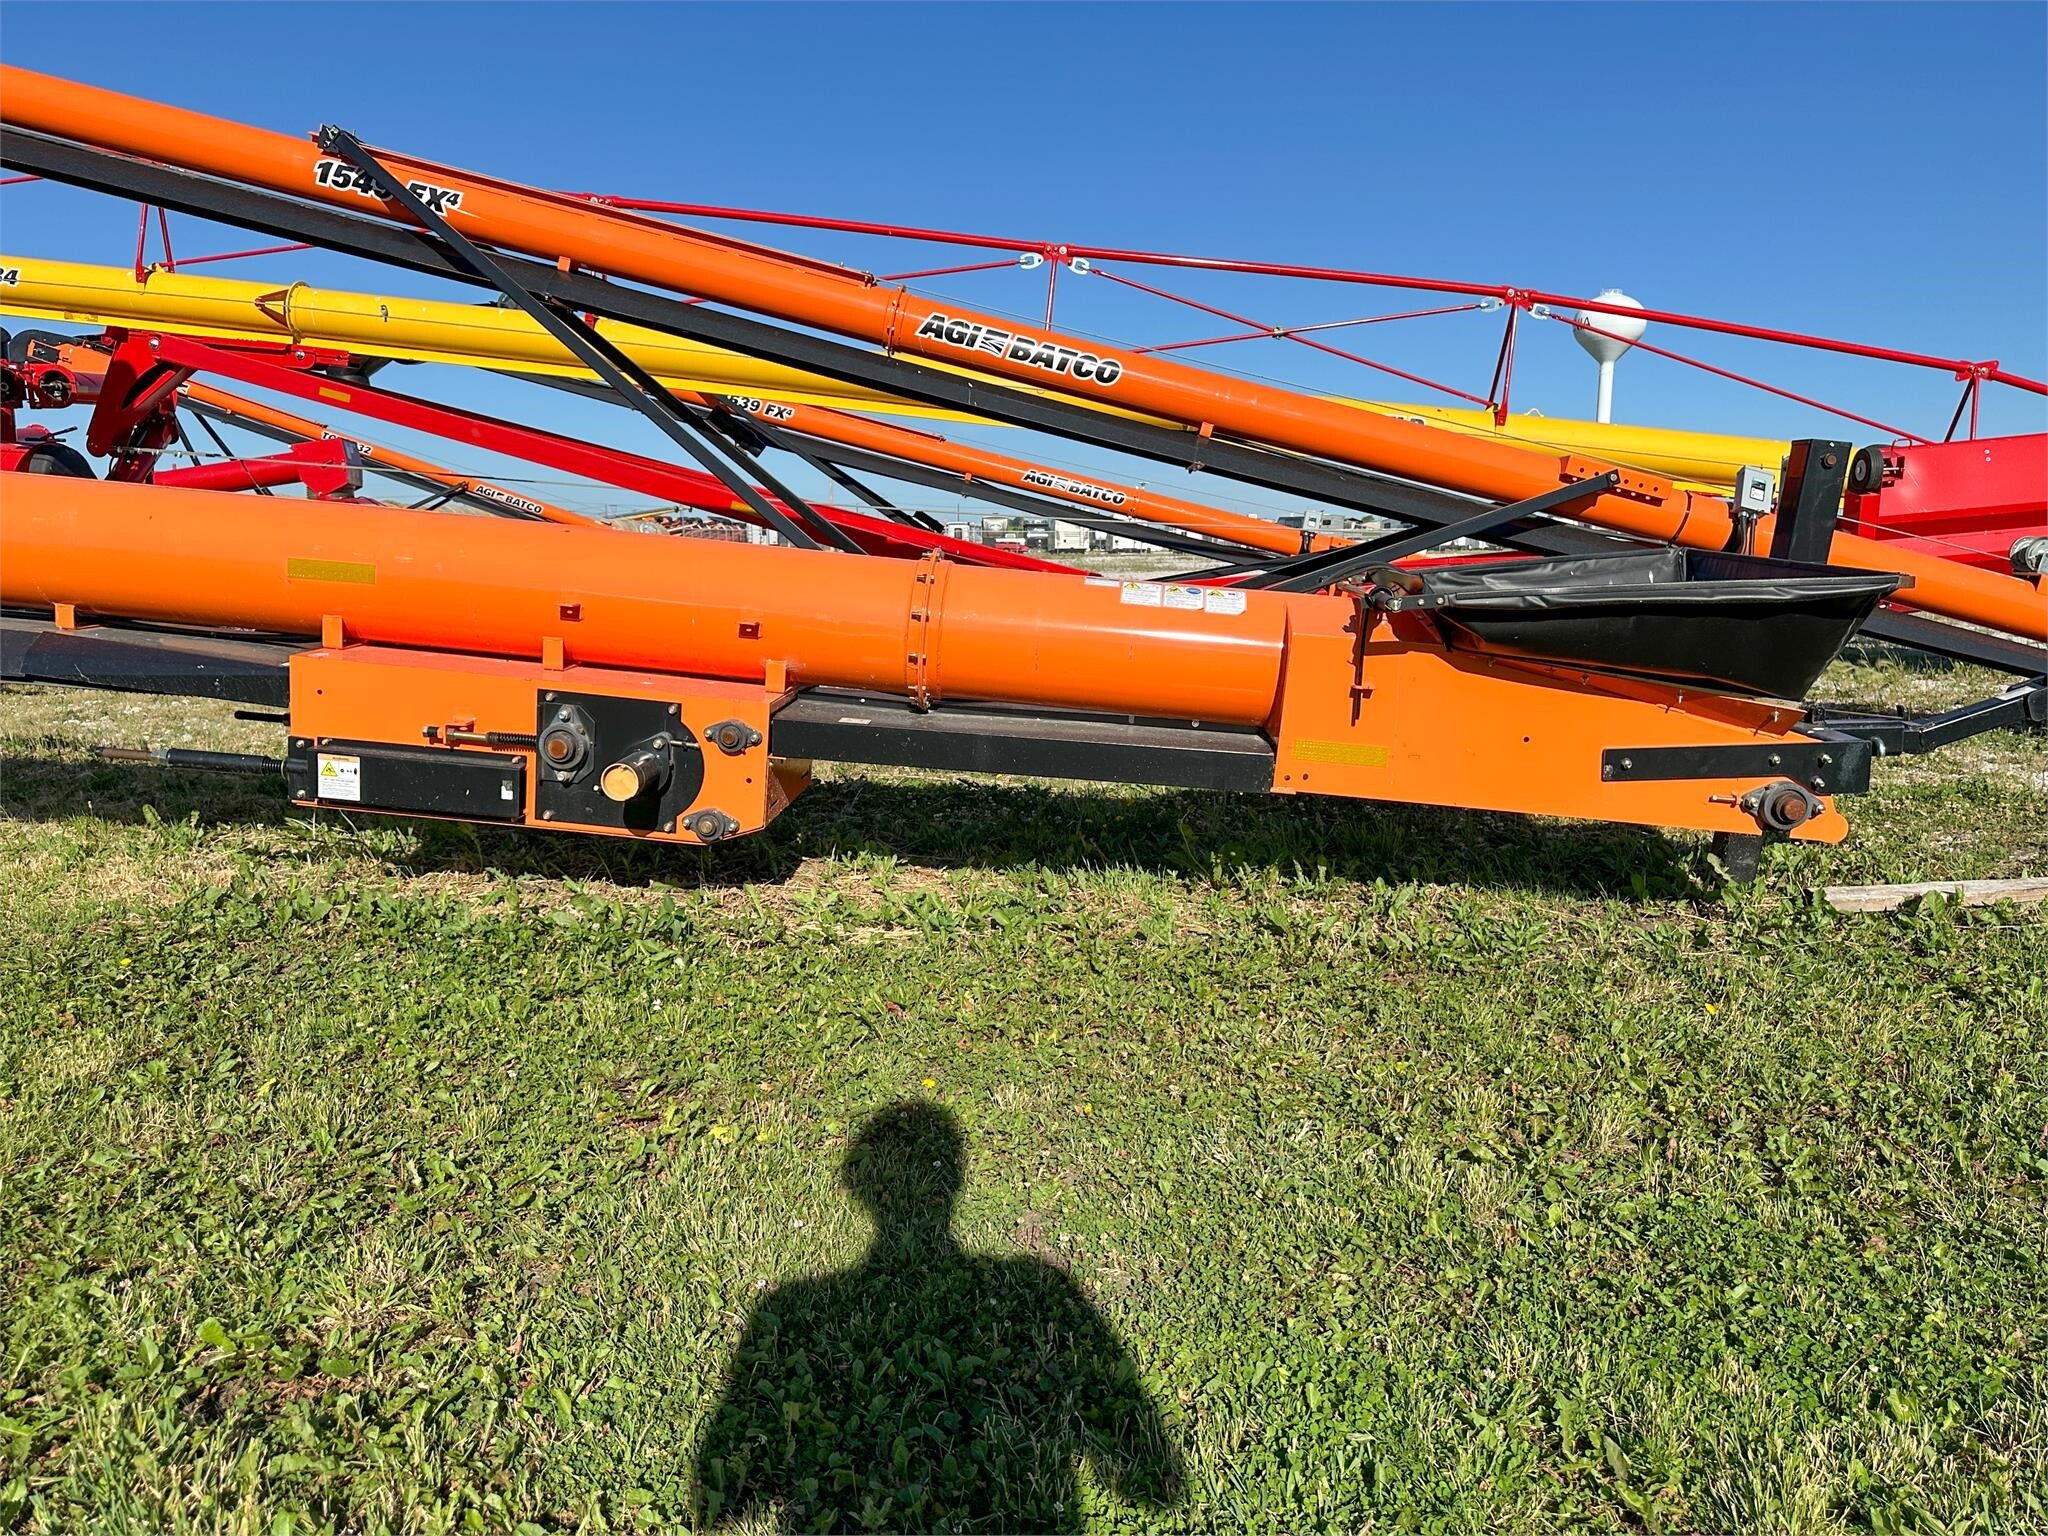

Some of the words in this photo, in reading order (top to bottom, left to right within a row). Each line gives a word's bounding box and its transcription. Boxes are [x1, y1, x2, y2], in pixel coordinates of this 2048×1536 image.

[918, 314, 983, 349] AGI
[1008, 337, 1121, 384] BATCO
[475, 485, 496, 498] AGI
[505, 495, 543, 513] BATCO
[1023, 470, 1056, 487] AGI
[1068, 480, 1126, 505] BATCO
